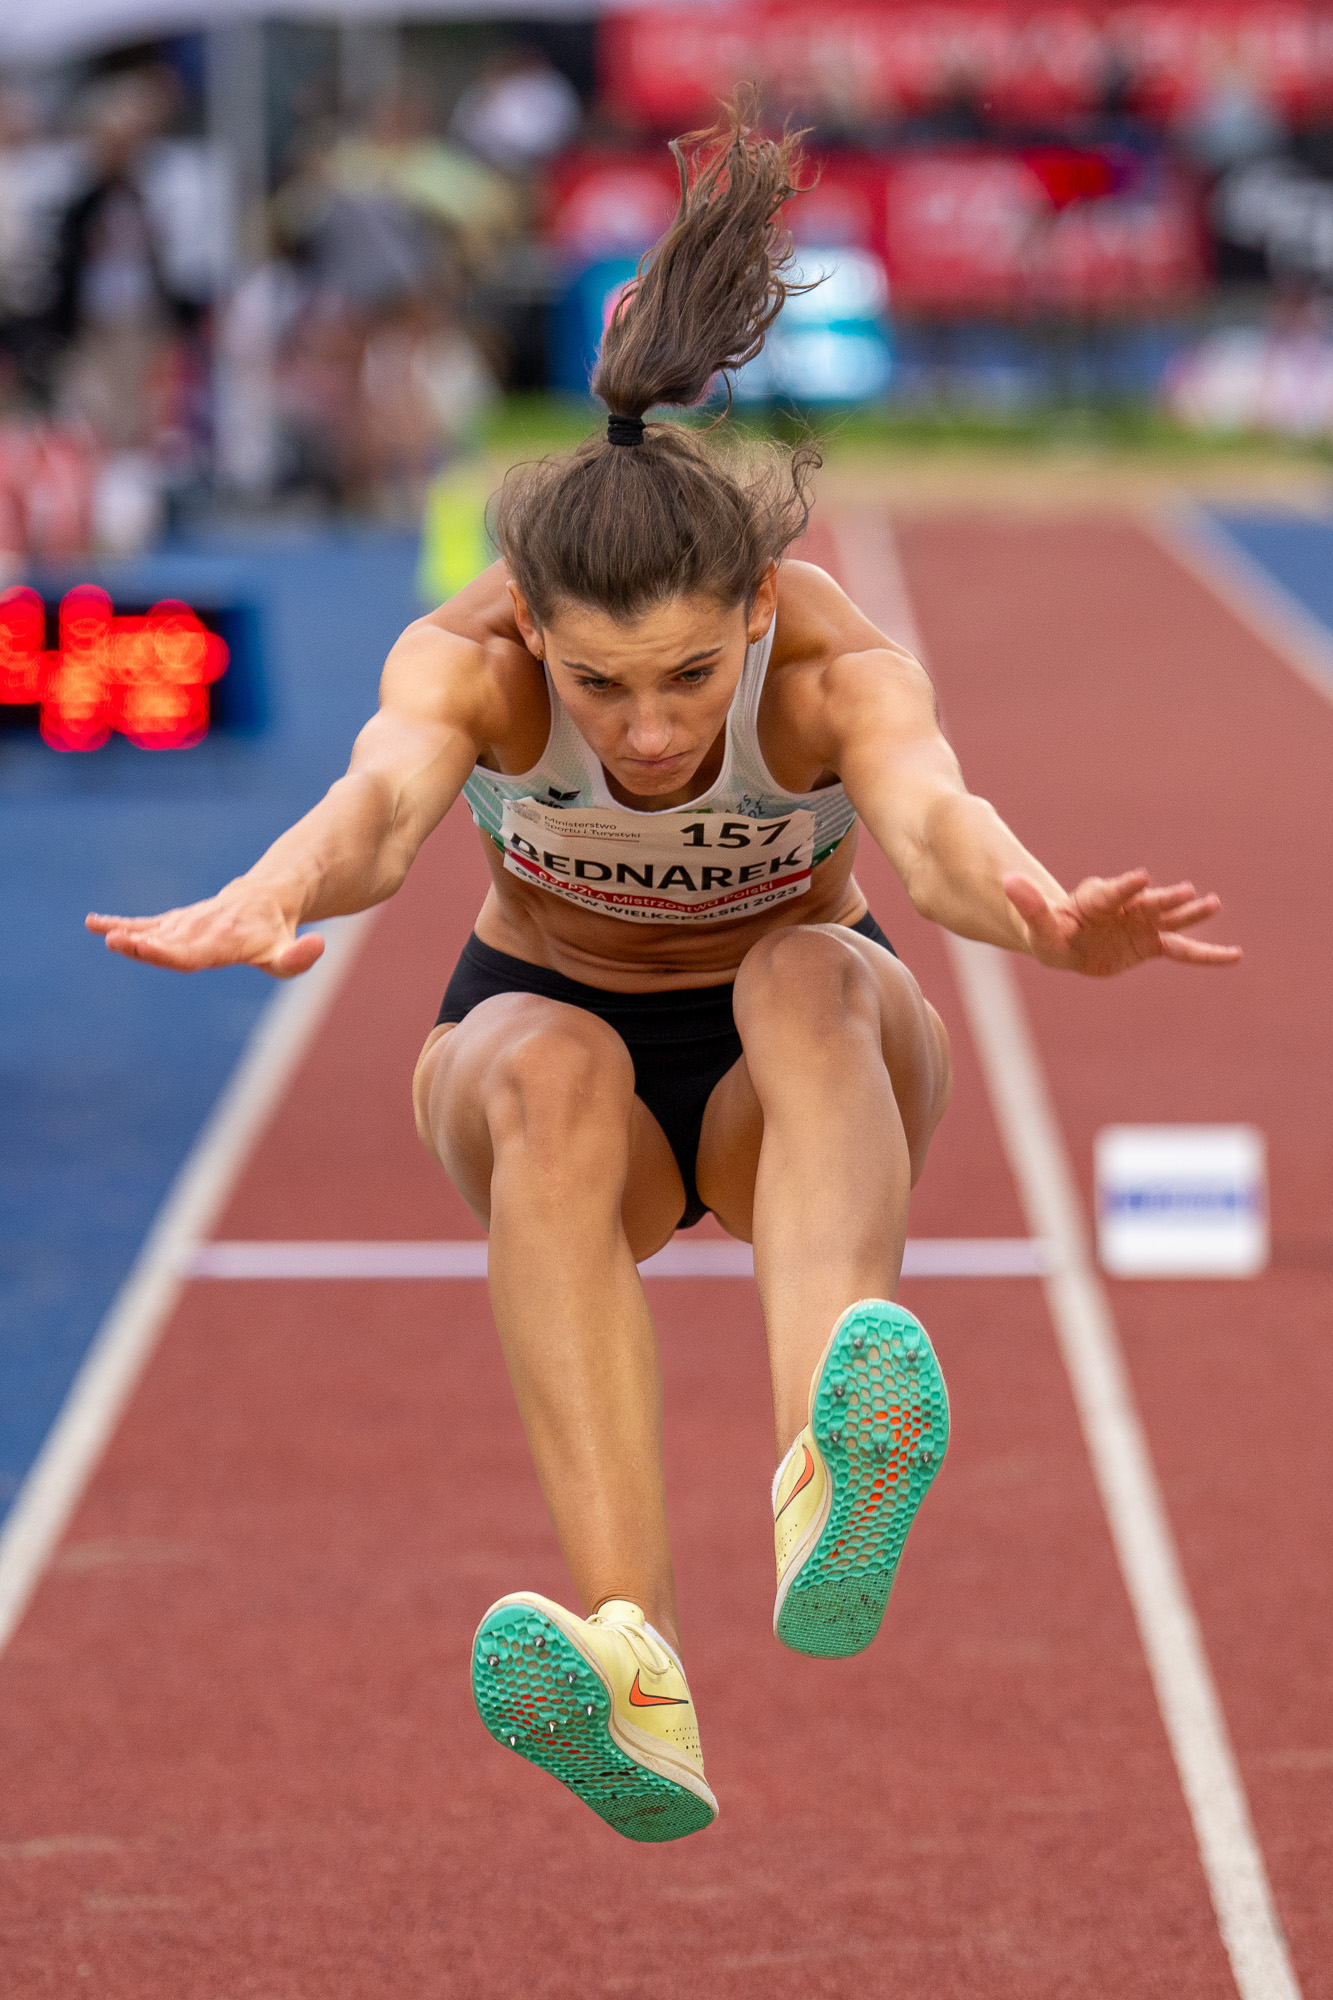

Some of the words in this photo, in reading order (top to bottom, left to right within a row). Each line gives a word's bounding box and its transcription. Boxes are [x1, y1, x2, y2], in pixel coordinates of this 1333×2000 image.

[544, 815, 617, 830] Ministerstwo
[544, 821, 580, 834] Sportu
[590, 828, 641, 840] Turystyki
[680, 818, 791, 849] 157
[510, 832, 802, 892] BEDNAREK
[604, 902, 748, 921] WIELKOPOLSKI
[752, 885, 798, 907] 2023
[612, 894, 719, 913] Mistrzostwa
[723, 881, 773, 903] Polski
